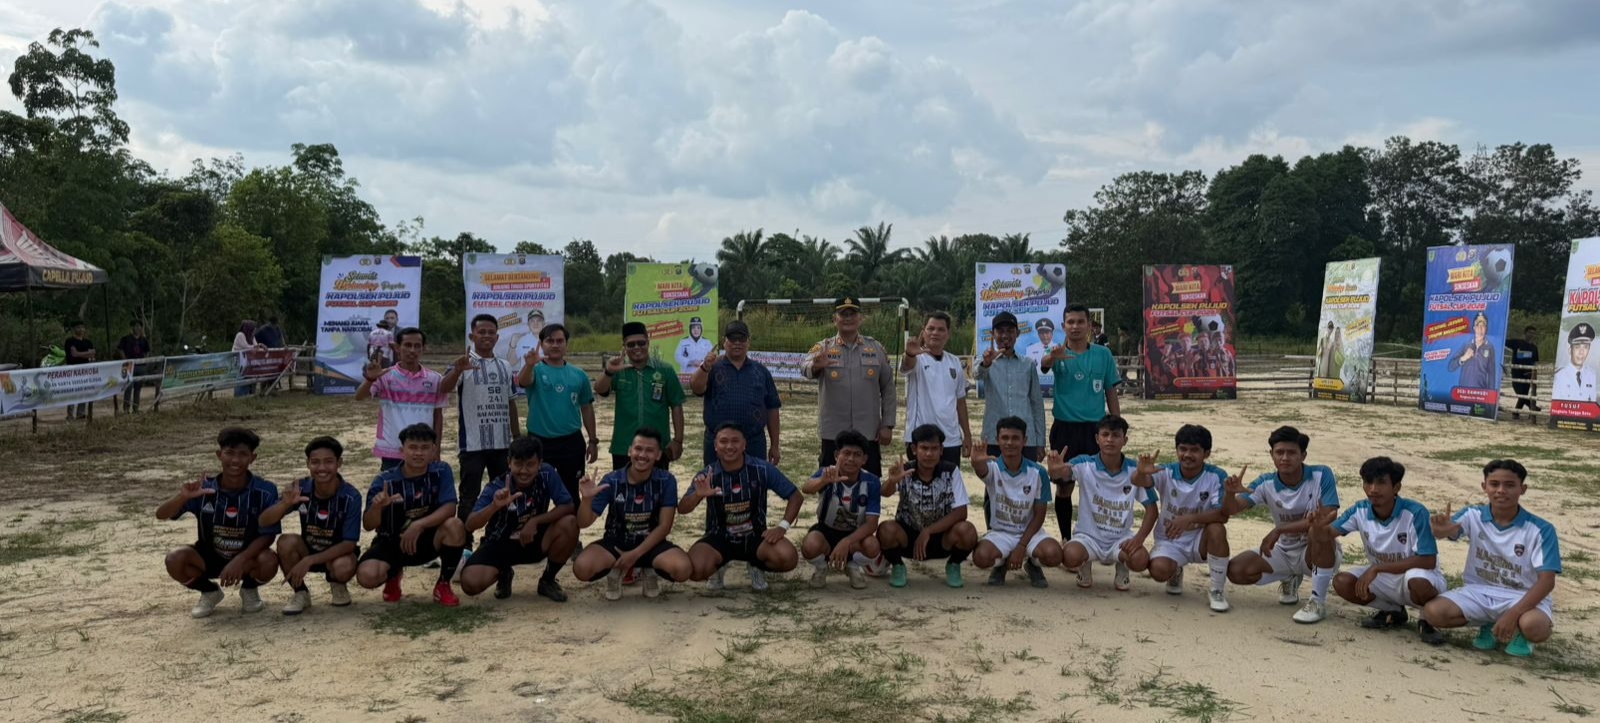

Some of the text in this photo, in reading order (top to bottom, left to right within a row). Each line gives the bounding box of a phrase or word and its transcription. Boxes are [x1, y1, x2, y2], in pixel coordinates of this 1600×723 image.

[42, 269, 93, 284] CAPELLA PUJUD
[484, 273, 506, 281] SELAMAT
[989, 279, 1022, 290] Selamat
[326, 291, 411, 300] KAPOLSEK PUJUD
[472, 292, 556, 300] KAPOLSEK PUJUD
[1468, 293, 1500, 301] PUJUD
[633, 298, 710, 310] KAPOLSEK PUJUD
[983, 298, 1059, 310] KAPOLSEK PUJUD
[1568, 304, 1597, 312] FUTSAL
[47, 367, 99, 380] PERANGI NARKOBA
